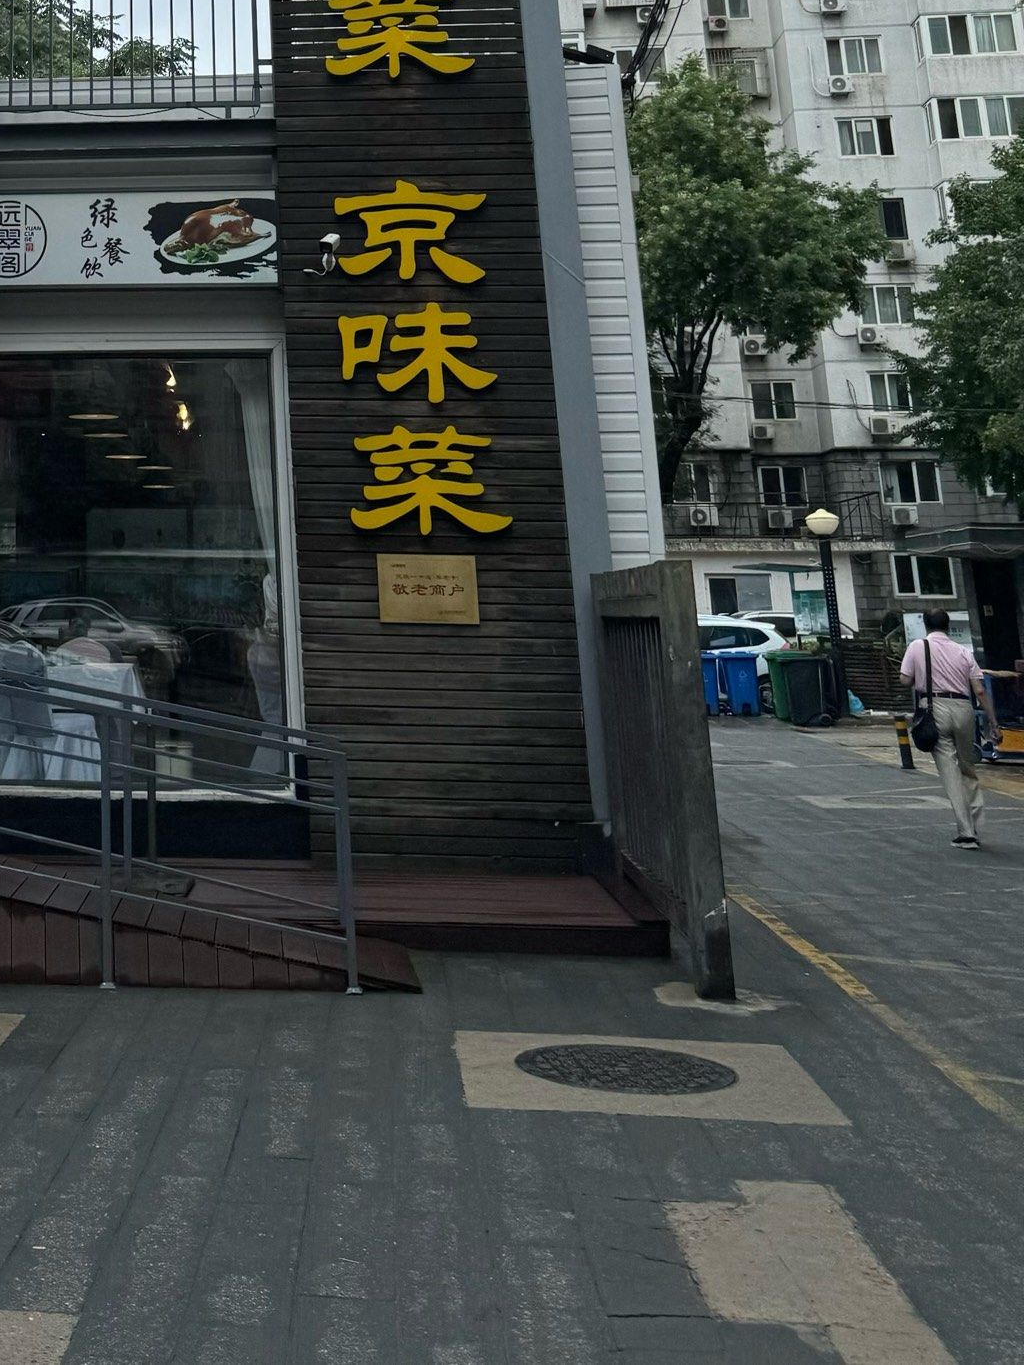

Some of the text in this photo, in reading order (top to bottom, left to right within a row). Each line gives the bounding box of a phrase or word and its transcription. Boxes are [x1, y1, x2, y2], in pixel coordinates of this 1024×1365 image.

[80, 197, 130, 279] 绿色餐饮
[333, 179, 513, 535] 京味菜
[391, 583, 465, 596] 敬老商户
